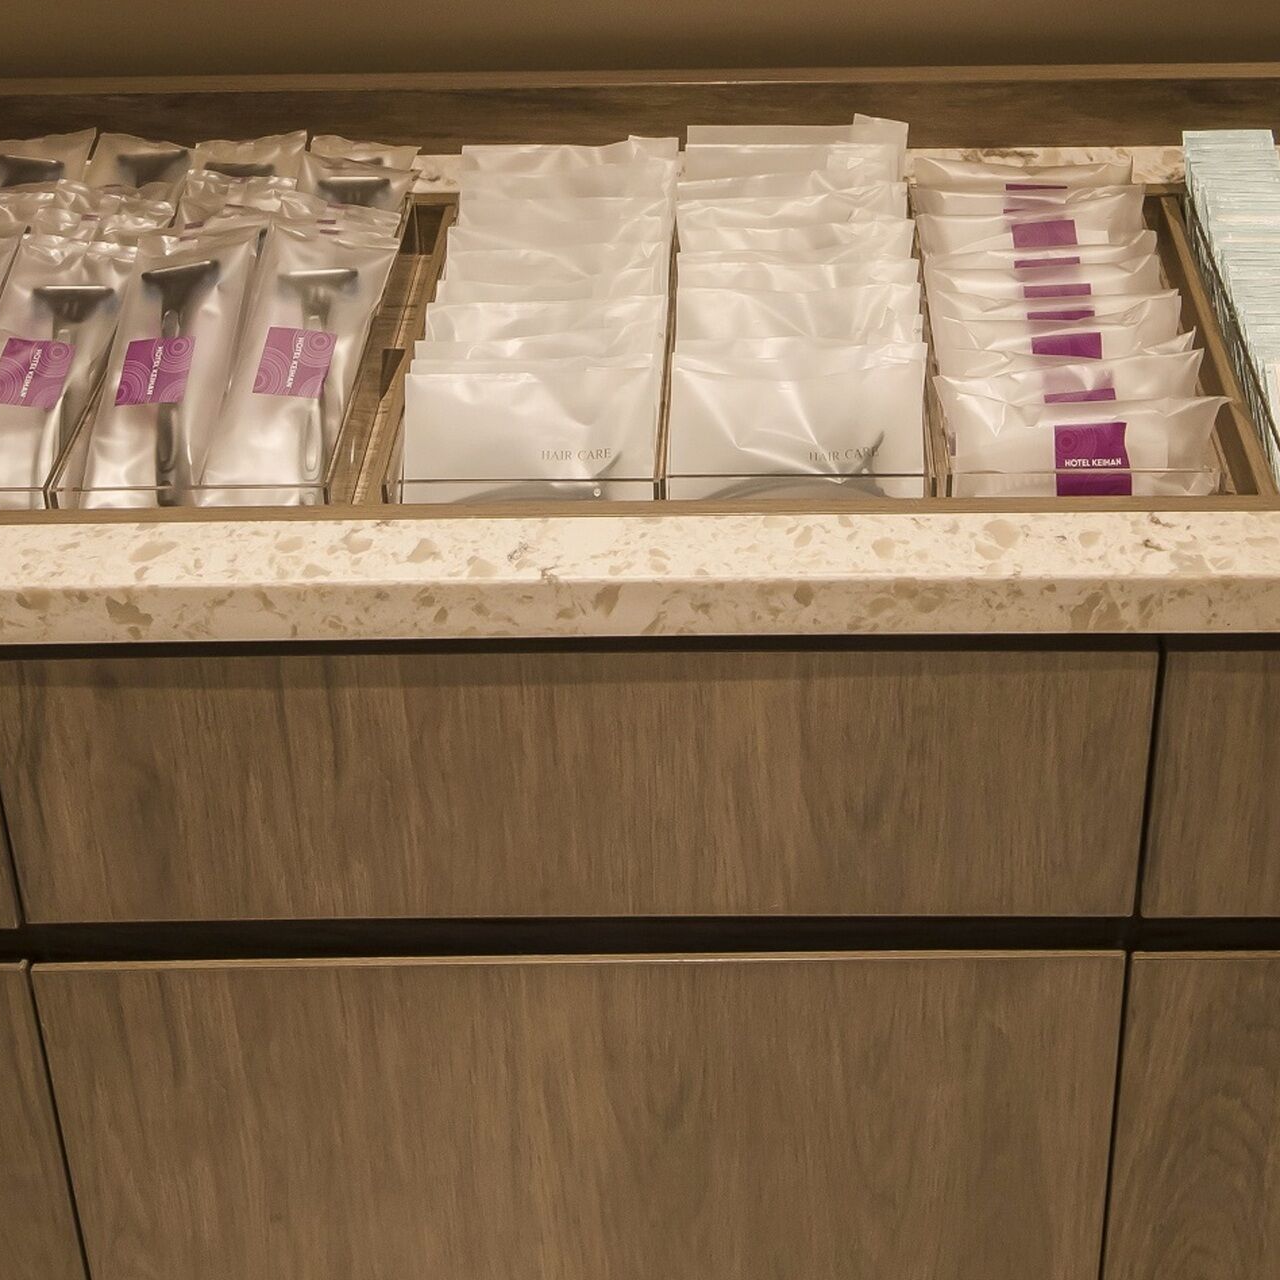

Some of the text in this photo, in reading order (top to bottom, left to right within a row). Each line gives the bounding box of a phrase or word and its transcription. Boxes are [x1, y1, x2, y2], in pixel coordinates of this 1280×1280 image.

[285, 335, 304, 388] HOTEL KEIHAN
[542, 448, 611, 460] HAIR CARE
[809, 446, 879, 461] HAIR CARE
[1064, 457, 1122, 467] HOTEL KEIHAN
